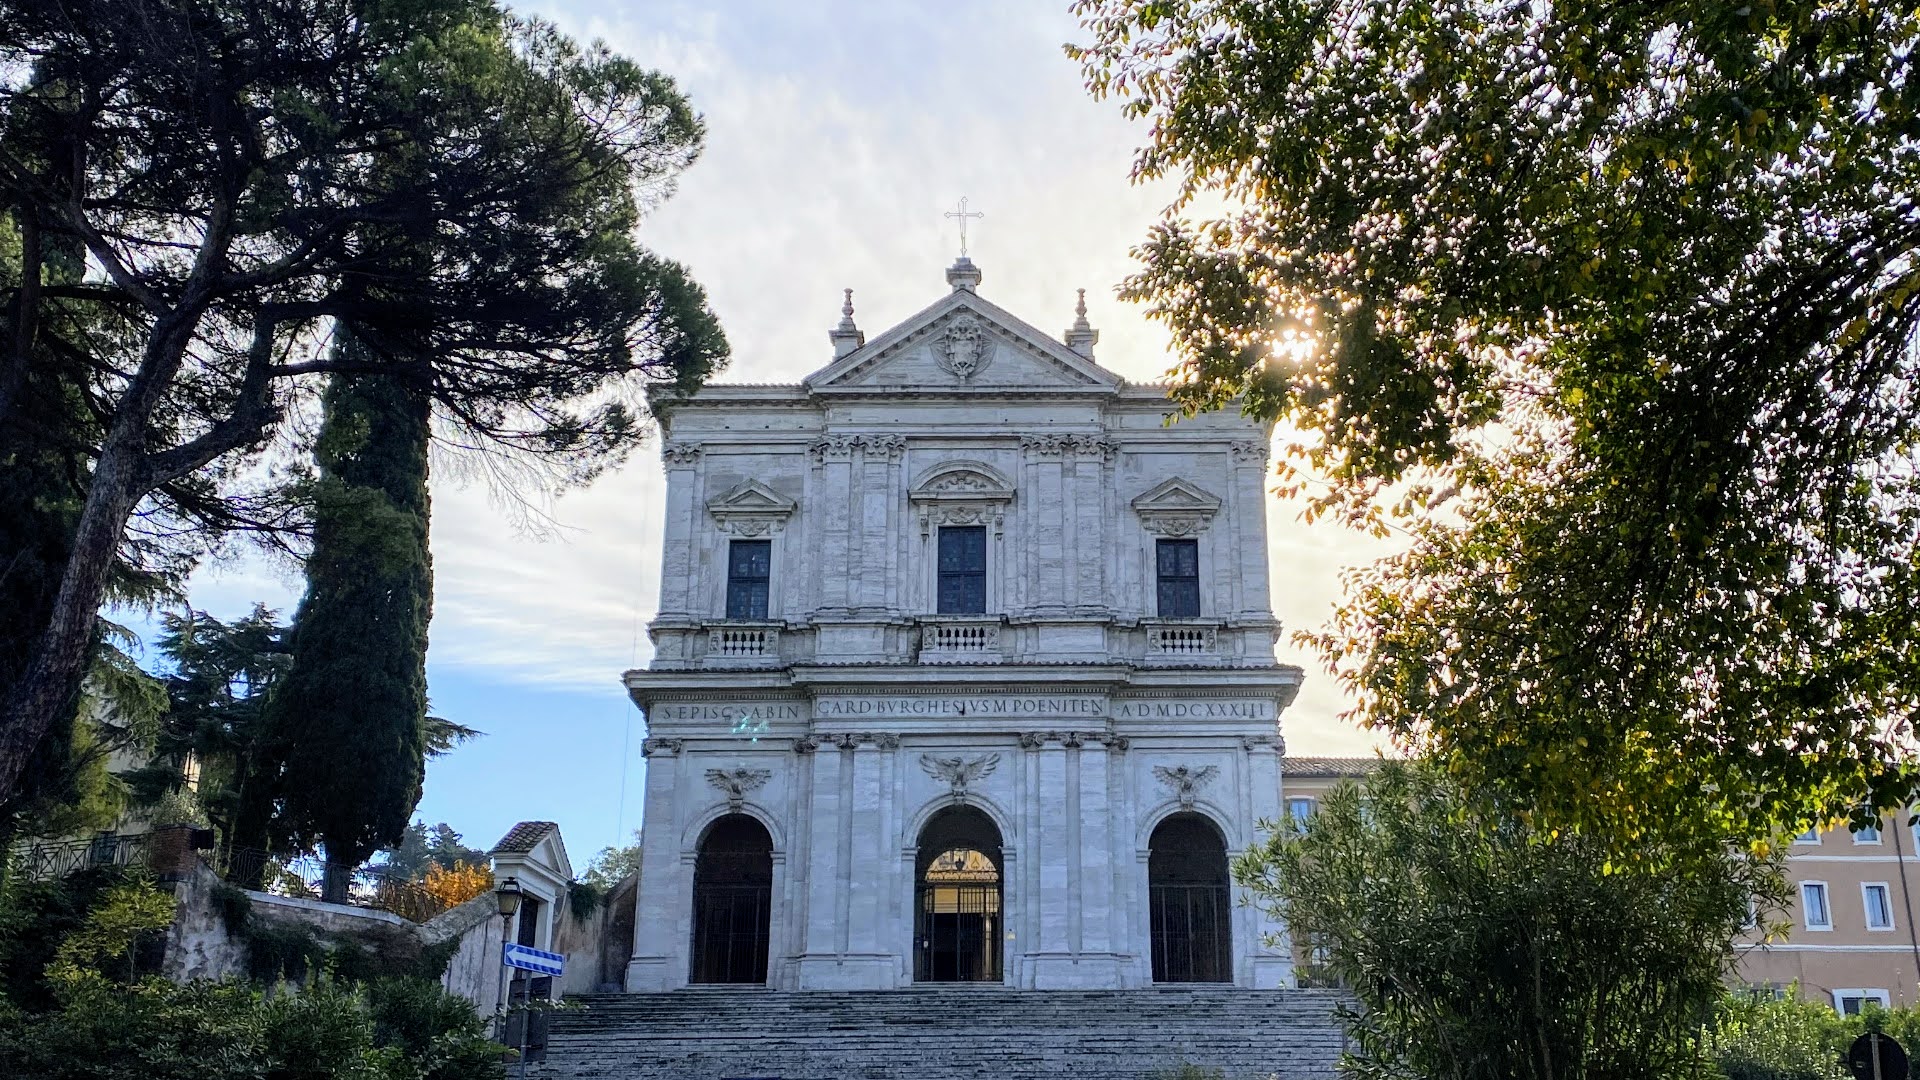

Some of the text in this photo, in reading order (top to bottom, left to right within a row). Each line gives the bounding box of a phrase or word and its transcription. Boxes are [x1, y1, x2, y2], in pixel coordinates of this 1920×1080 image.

[739, 705, 800, 719] SABIN
[818, 700, 871, 714] CARD
[1013, 699, 1104, 713] POENITEN
